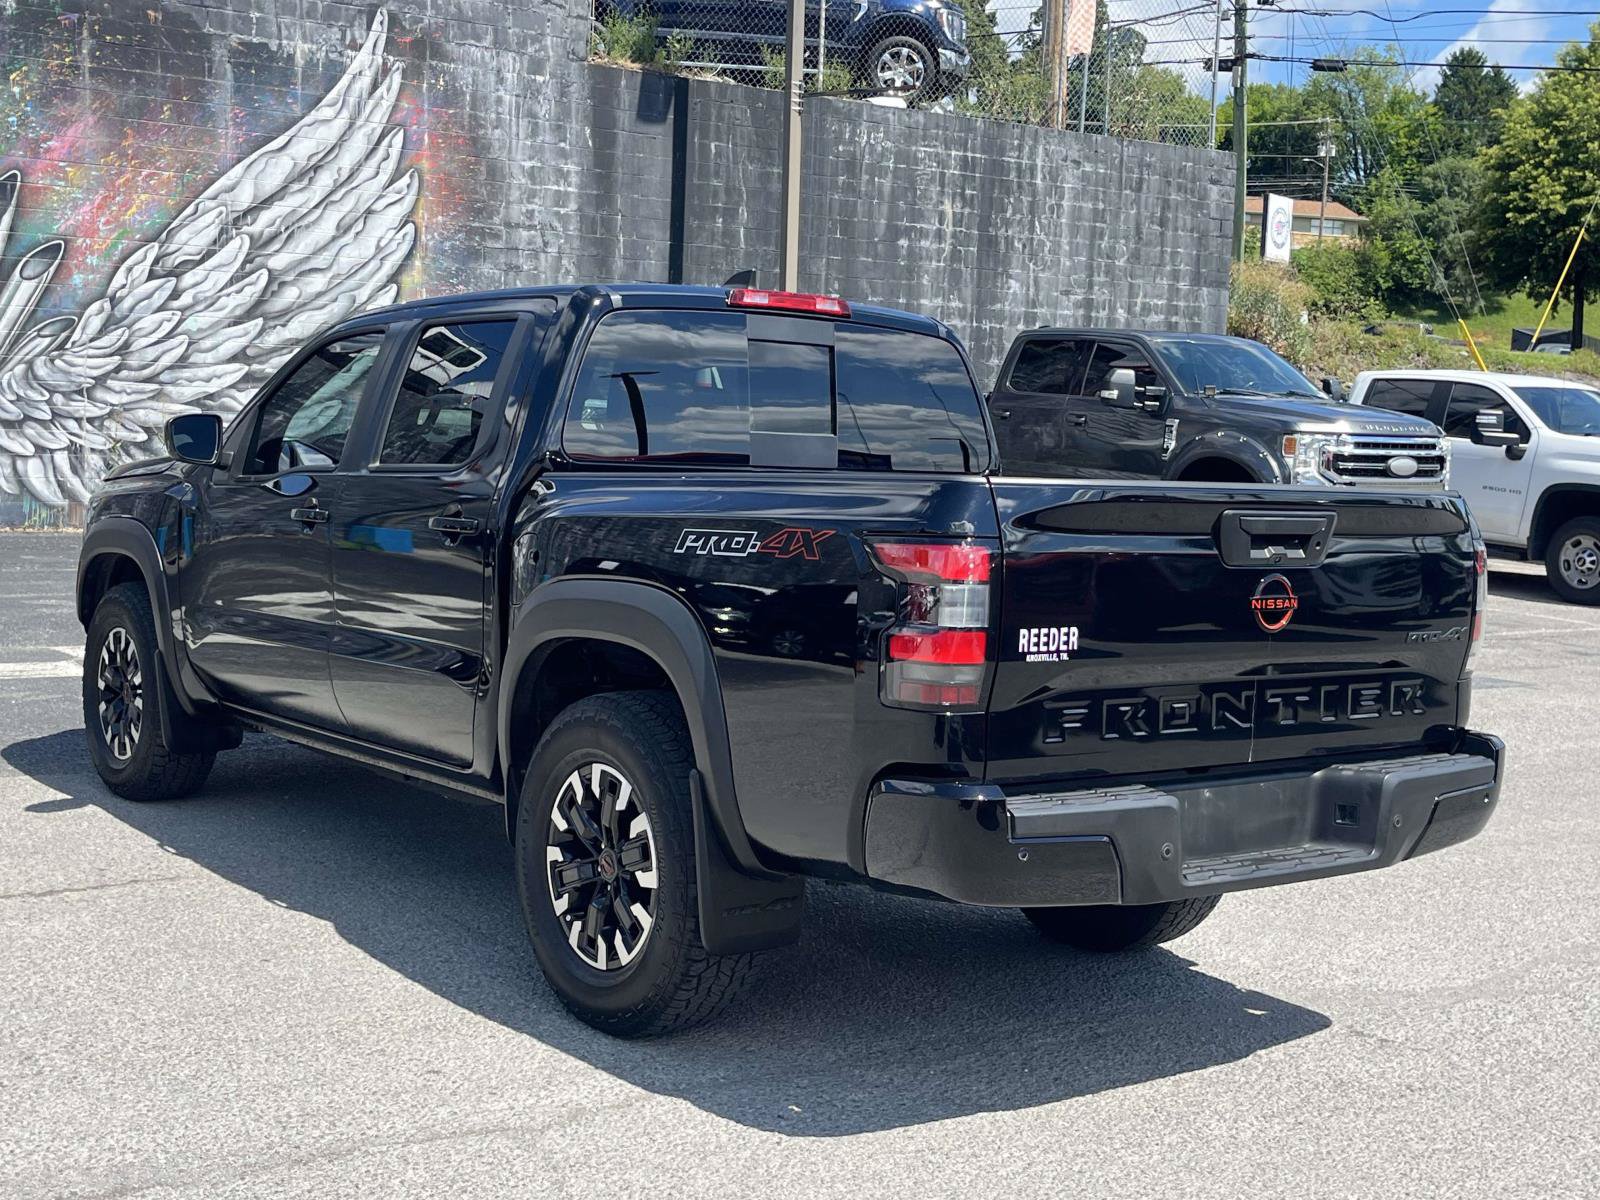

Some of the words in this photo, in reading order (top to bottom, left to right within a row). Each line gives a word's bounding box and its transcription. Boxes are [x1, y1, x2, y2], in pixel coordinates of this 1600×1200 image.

[1251, 598, 1298, 609] NISSAN
[1018, 626, 1079, 653] REEDER
[1043, 677, 1426, 743] FRONTIER
